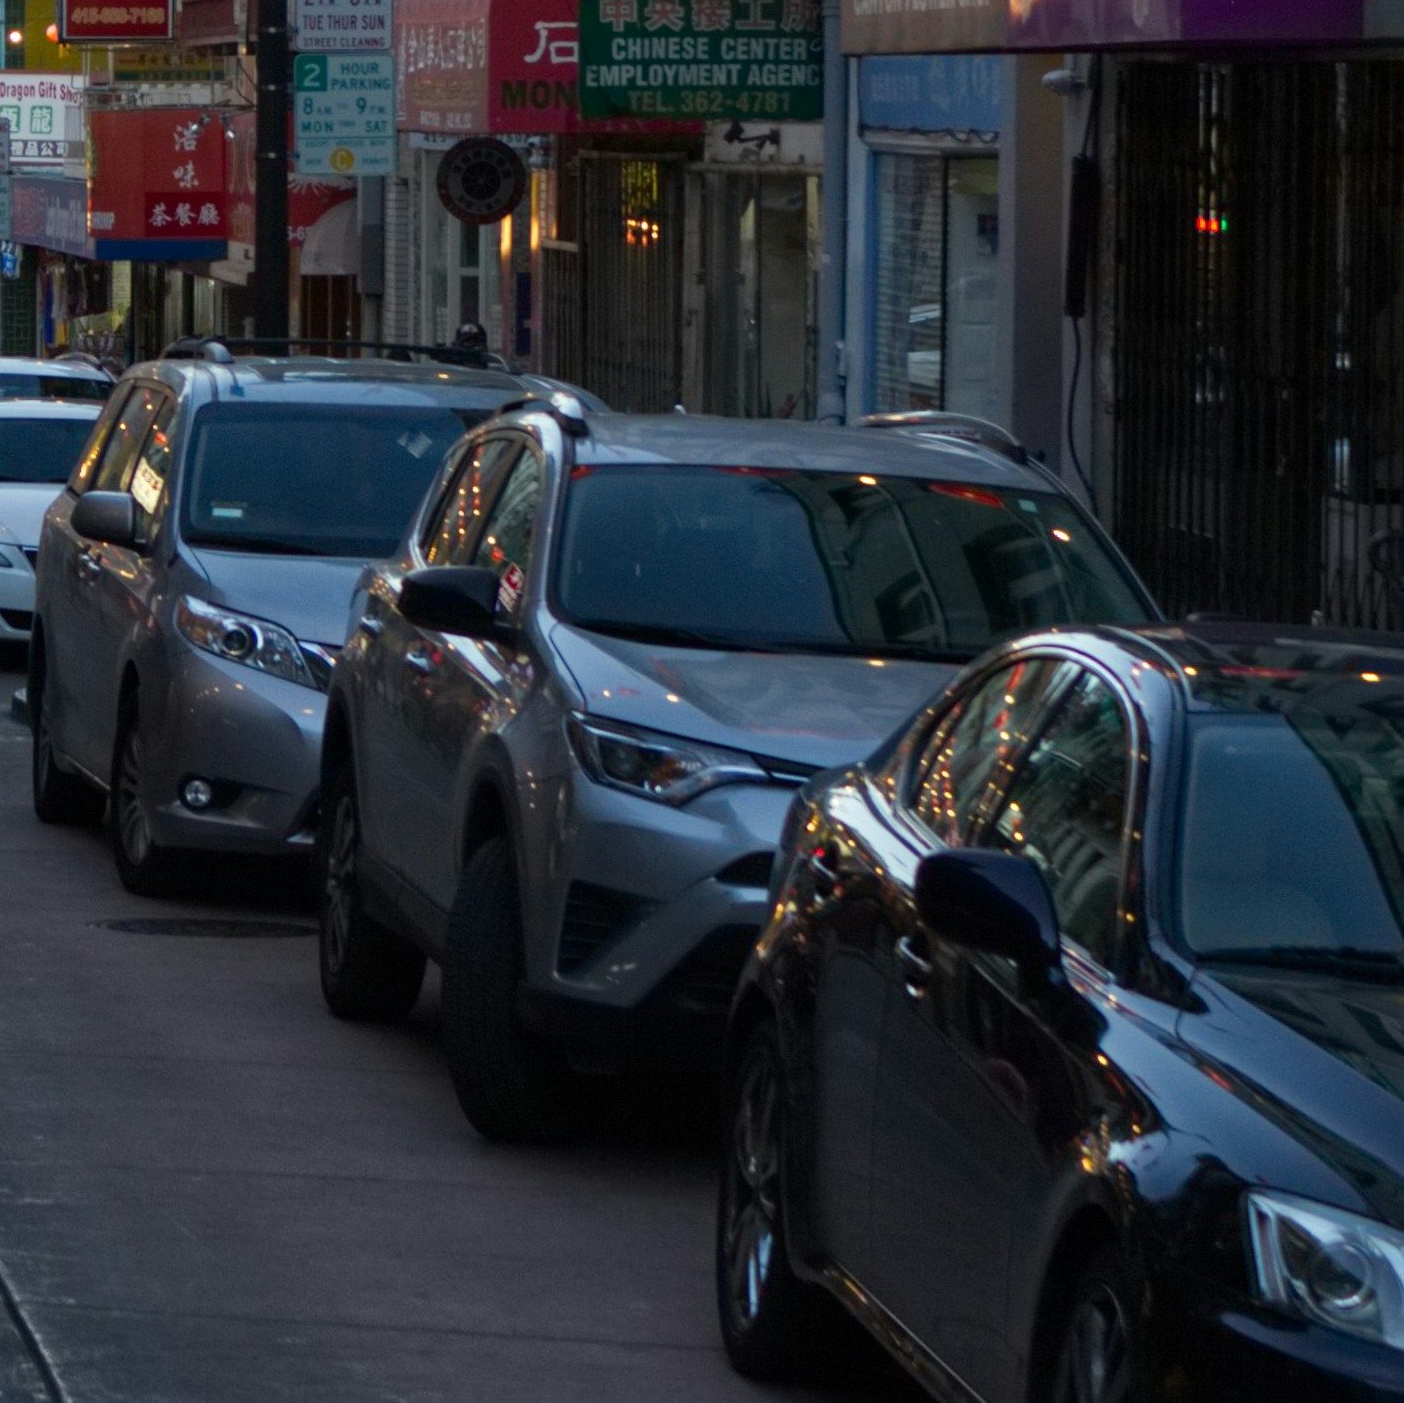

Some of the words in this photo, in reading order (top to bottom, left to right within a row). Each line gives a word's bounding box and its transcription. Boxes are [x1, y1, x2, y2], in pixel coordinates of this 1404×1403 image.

[303, 15, 323, 31] TUE
[328, 15, 357, 31] THUR
[361, 15, 385, 31] SUN
[303, 37, 337, 47] STREET
[340, 37, 385, 47] CLEANING
[611, 38, 710, 61] CHINESE
[720, 38, 807, 61] CENTER
[304, 63, 321, 88] 2
[341, 63, 379, 74] HOUR
[331, 78, 390, 90] PARKING
[585, 64, 741, 88] EMPLOYMENT
[747, 64, 822, 87] AGENC
[0, 82, 35, 100] Dragon
[38, 82, 57, 100] Gift
[303, 97, 314, 114] 8
[356, 97, 367, 114] 9
[301, 121, 334, 132] MON
[366, 121, 388, 132] SAT
